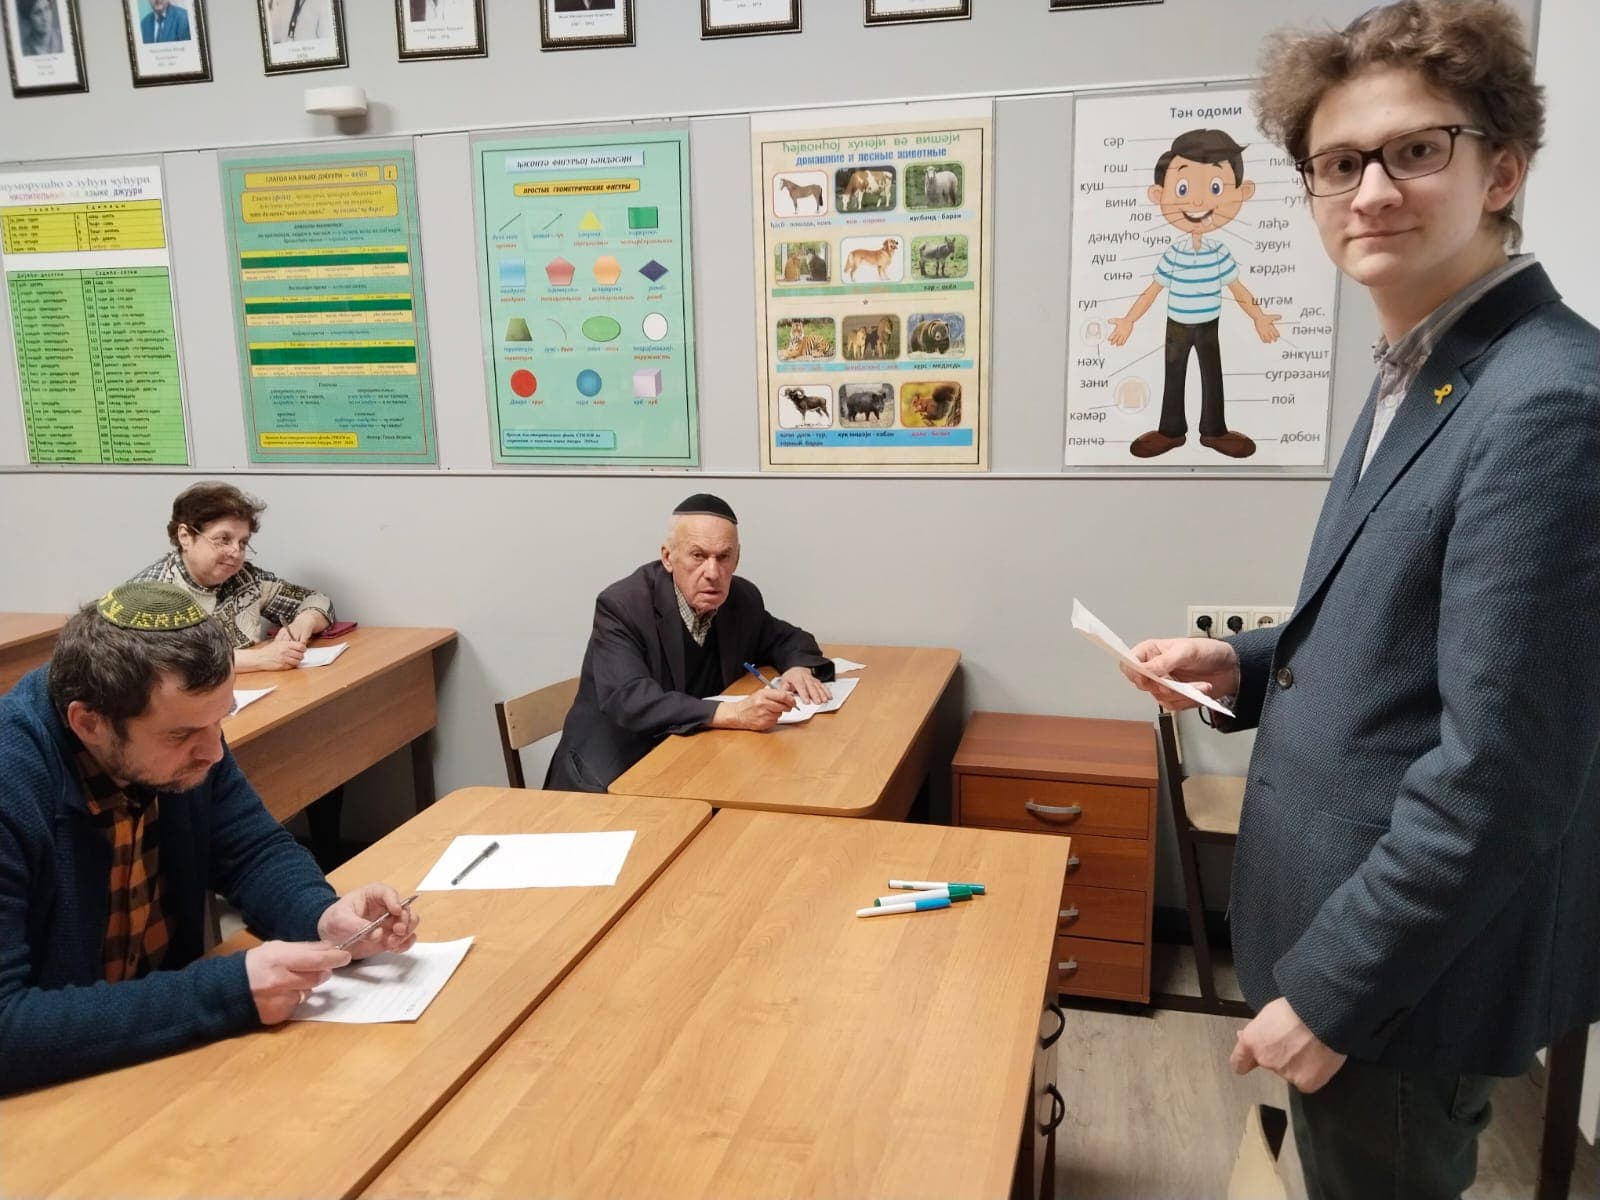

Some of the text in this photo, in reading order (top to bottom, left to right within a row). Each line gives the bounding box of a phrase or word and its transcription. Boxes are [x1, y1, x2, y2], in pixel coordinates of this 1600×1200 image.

[1169, 106, 1243, 120] Тән одоми
[1103, 137, 1125, 149] сәр
[795, 147, 947, 167] домашние и лесные животные
[1104, 163, 1128, 173] гош
[113, 186, 143, 198] джуури
[523, 183, 631, 194] ПРОСТЫЕ ГЕОМЕТРИЧЕСКИЕ ФИГУРЫ
[1080, 181, 1105, 193] куш
[1105, 198, 1137, 208] вини
[1129, 212, 1152, 222] лов
[1255, 240, 1292, 253] зувун
[1103, 271, 1133, 282] синә
[1078, 299, 1097, 311] гул
[1080, 379, 1109, 389] зани
[1271, 393, 1296, 405] пой
[1069, 411, 1107, 424] кәмәр
[1280, 431, 1321, 444] добон
